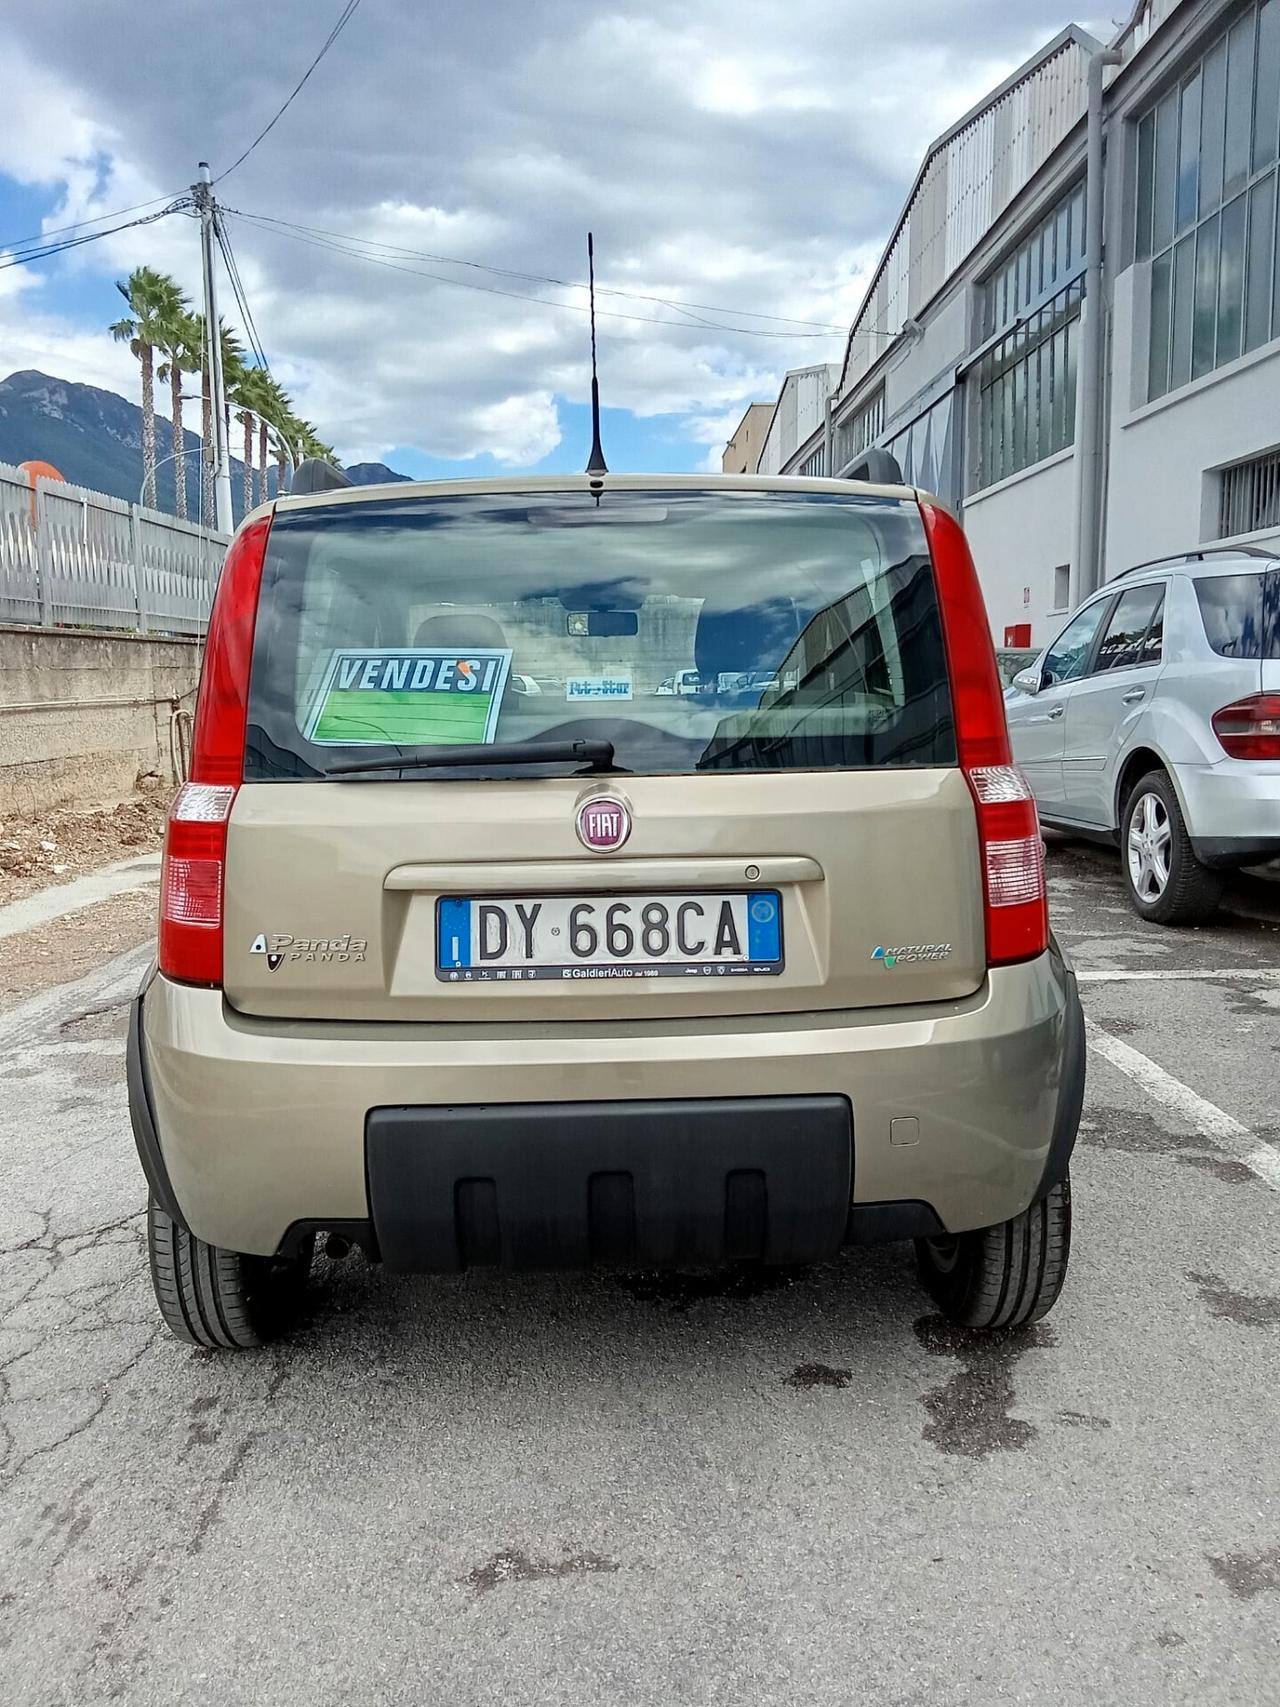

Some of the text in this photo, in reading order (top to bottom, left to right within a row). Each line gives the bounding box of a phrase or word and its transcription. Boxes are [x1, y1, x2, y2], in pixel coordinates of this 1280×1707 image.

[338, 659, 497, 691] VENDESI
[588, 813, 620, 838] FIAT
[478, 900, 743, 961] DY 668CA
[270, 934, 367, 952] Panda
[886, 944, 952, 956] NATURAL
[290, 952, 366, 962] PANDA
[896, 952, 949, 963] POWER
